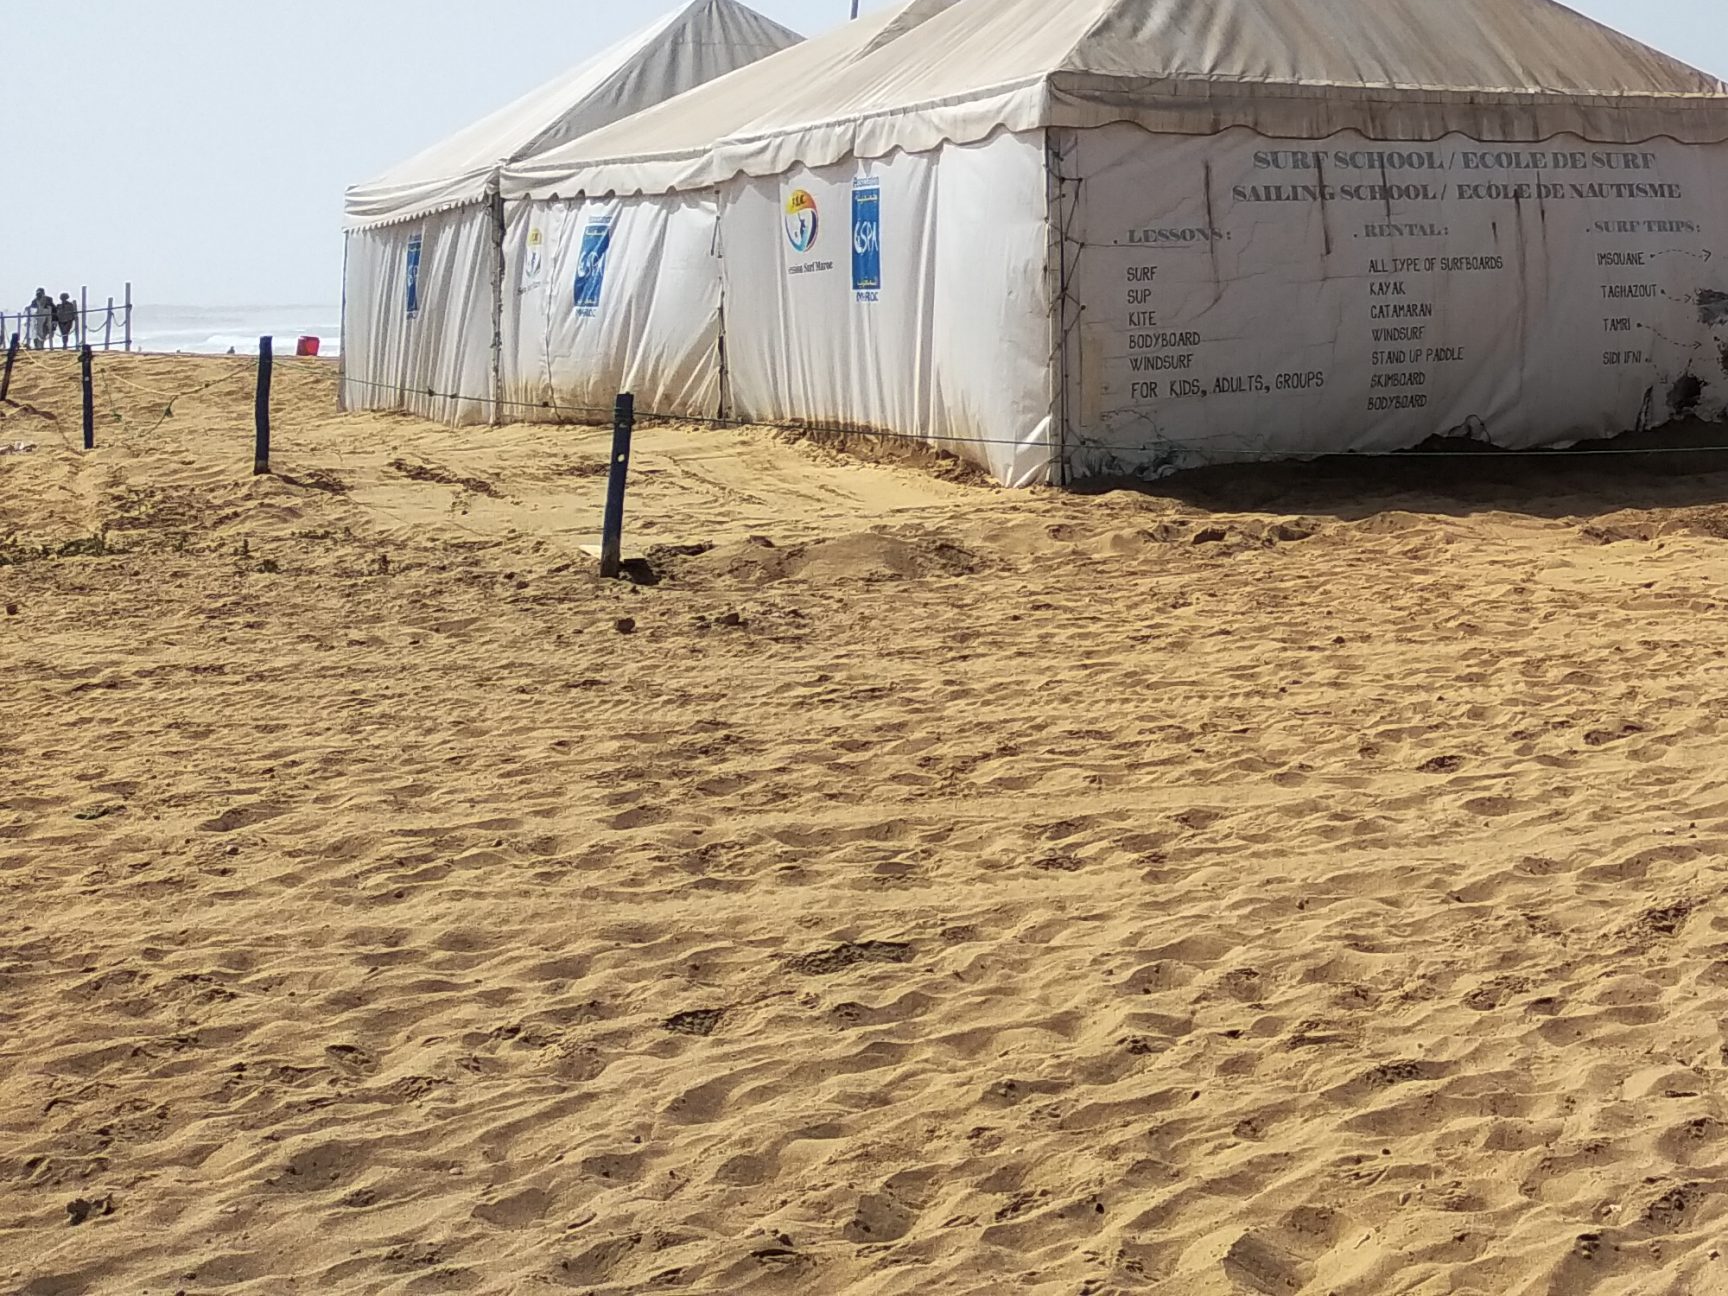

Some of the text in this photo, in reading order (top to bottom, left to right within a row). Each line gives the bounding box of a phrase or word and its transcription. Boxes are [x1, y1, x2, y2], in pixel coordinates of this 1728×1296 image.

[1253, 150, 1329, 170] SURF
[1334, 150, 1444, 170] SCHOOL
[1461, 151, 1546, 170] ECOLE
[1552, 151, 1587, 170] DE
[1592, 152, 1656, 170] SURF
[1232, 184, 1335, 202] SAILING
[1340, 183, 1437, 201] SCHOOL
[1456, 183, 1532, 200] ECOLE
[1537, 183, 1565, 199] DE
[1569, 183, 1682, 199] NAUTISME
[1594, 220, 1640, 233] SURF
[1368, 256, 1503, 273] ALL TYPE OF SURFBOARDS
[1597, 252, 1645, 266] IMSOUANE
[1127, 266, 1158, 282] SURF
[1127, 289, 1152, 304] SUP
[1369, 281, 1406, 296] KAYAK
[1601, 284, 1657, 299] TAGHAZOUT
[1128, 311, 1157, 326] KITE
[1370, 303, 1432, 319] CATAMARAN
[1603, 317, 1631, 332] TAMRI
[1128, 331, 1200, 349] BODYBOARD
[1371, 325, 1425, 342] WINDSURF
[1129, 354, 1194, 371] WINDSURF
[1371, 346, 1464, 366] STAND UP PADDLE
[1602, 350, 1643, 366] SIDI IFNI
[1131, 371, 1324, 399] FOR KIDS, ADULTS, GROUPS
[1370, 371, 1426, 388] SKIMBOARD
[1367, 394, 1427, 411] BODYBOARD
